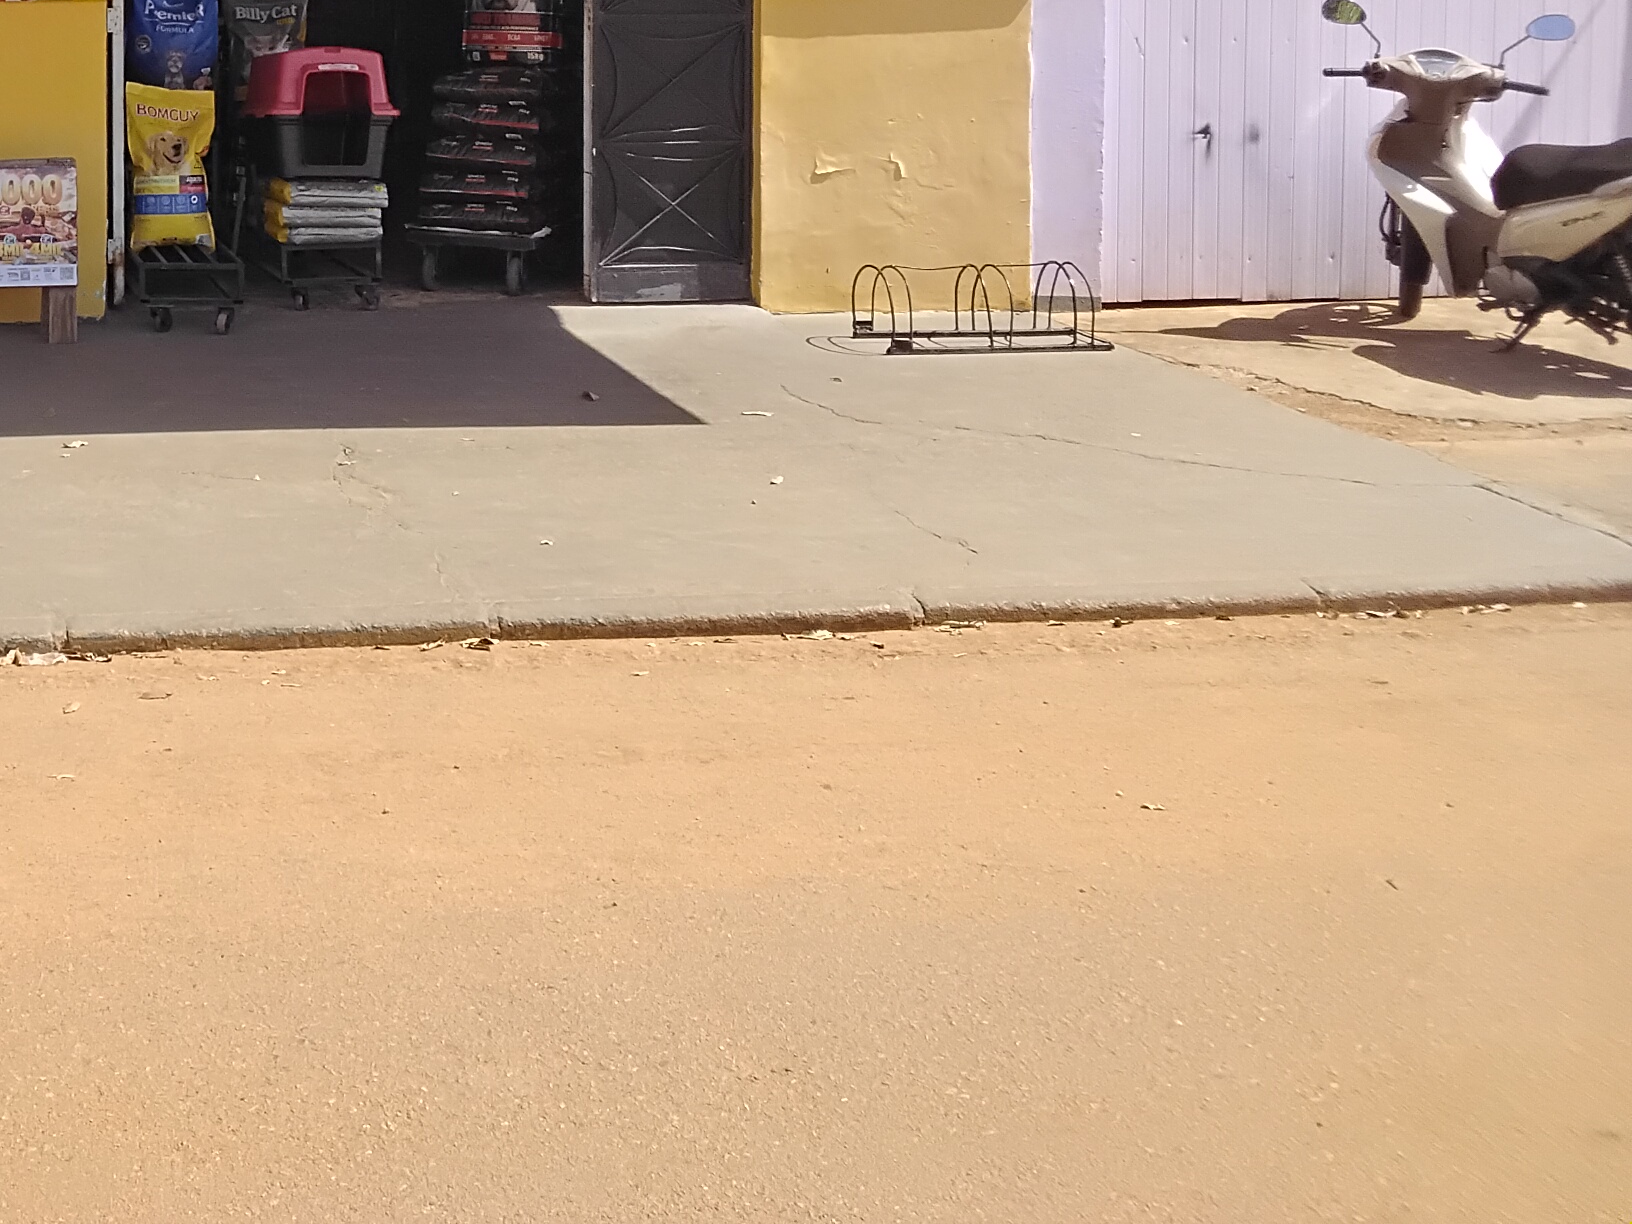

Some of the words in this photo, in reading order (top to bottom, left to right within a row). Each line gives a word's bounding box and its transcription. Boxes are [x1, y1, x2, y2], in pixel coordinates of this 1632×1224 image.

[234, 6, 270, 24] Billy
[271, 4, 297, 19] Cat
[136, 103, 200, 123] BOMGUY
